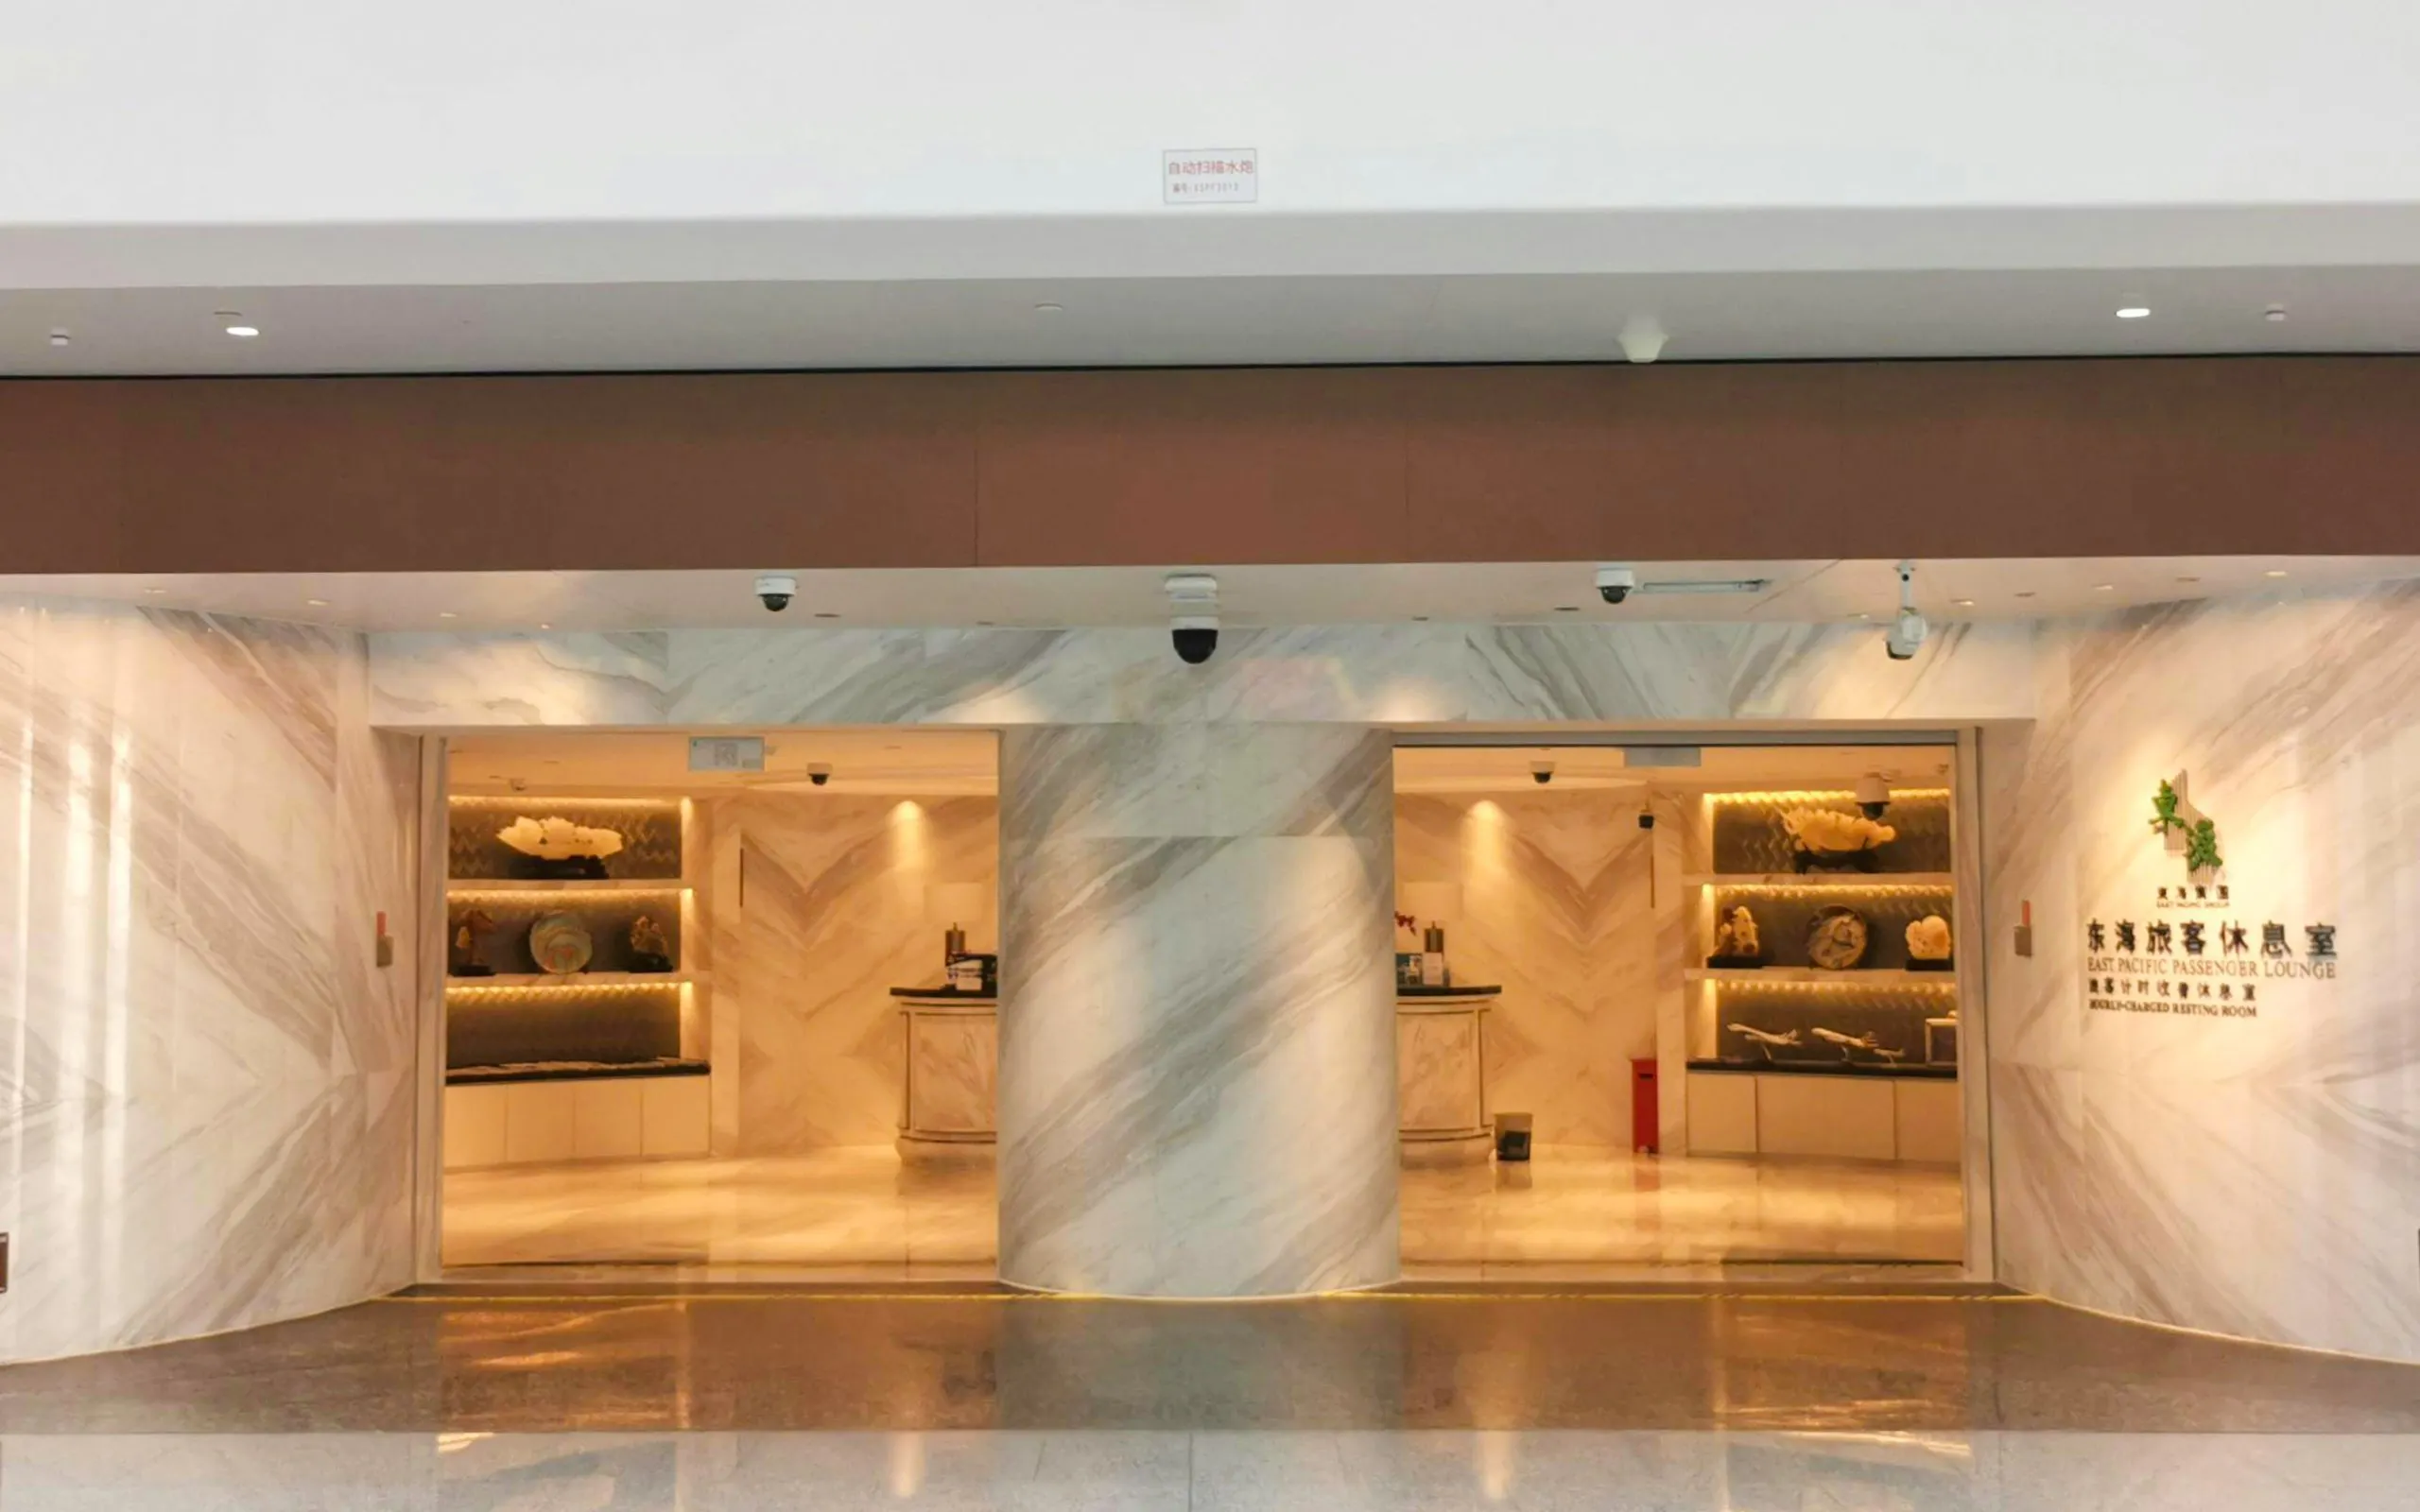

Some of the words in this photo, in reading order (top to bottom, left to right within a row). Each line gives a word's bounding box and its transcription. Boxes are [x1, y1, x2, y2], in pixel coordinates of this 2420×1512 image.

[2086, 918, 2337, 959] 东海旅客休息室
[2087, 955, 2115, 972] EAST
[2118, 957, 2168, 975] PACIFIC
[2172, 959, 2258, 977] PASSENGER
[2264, 960, 2336, 979] LOUNGE
[2172, 1003, 2218, 1017] RESTING
[2221, 1005, 2257, 1018] ROOM
